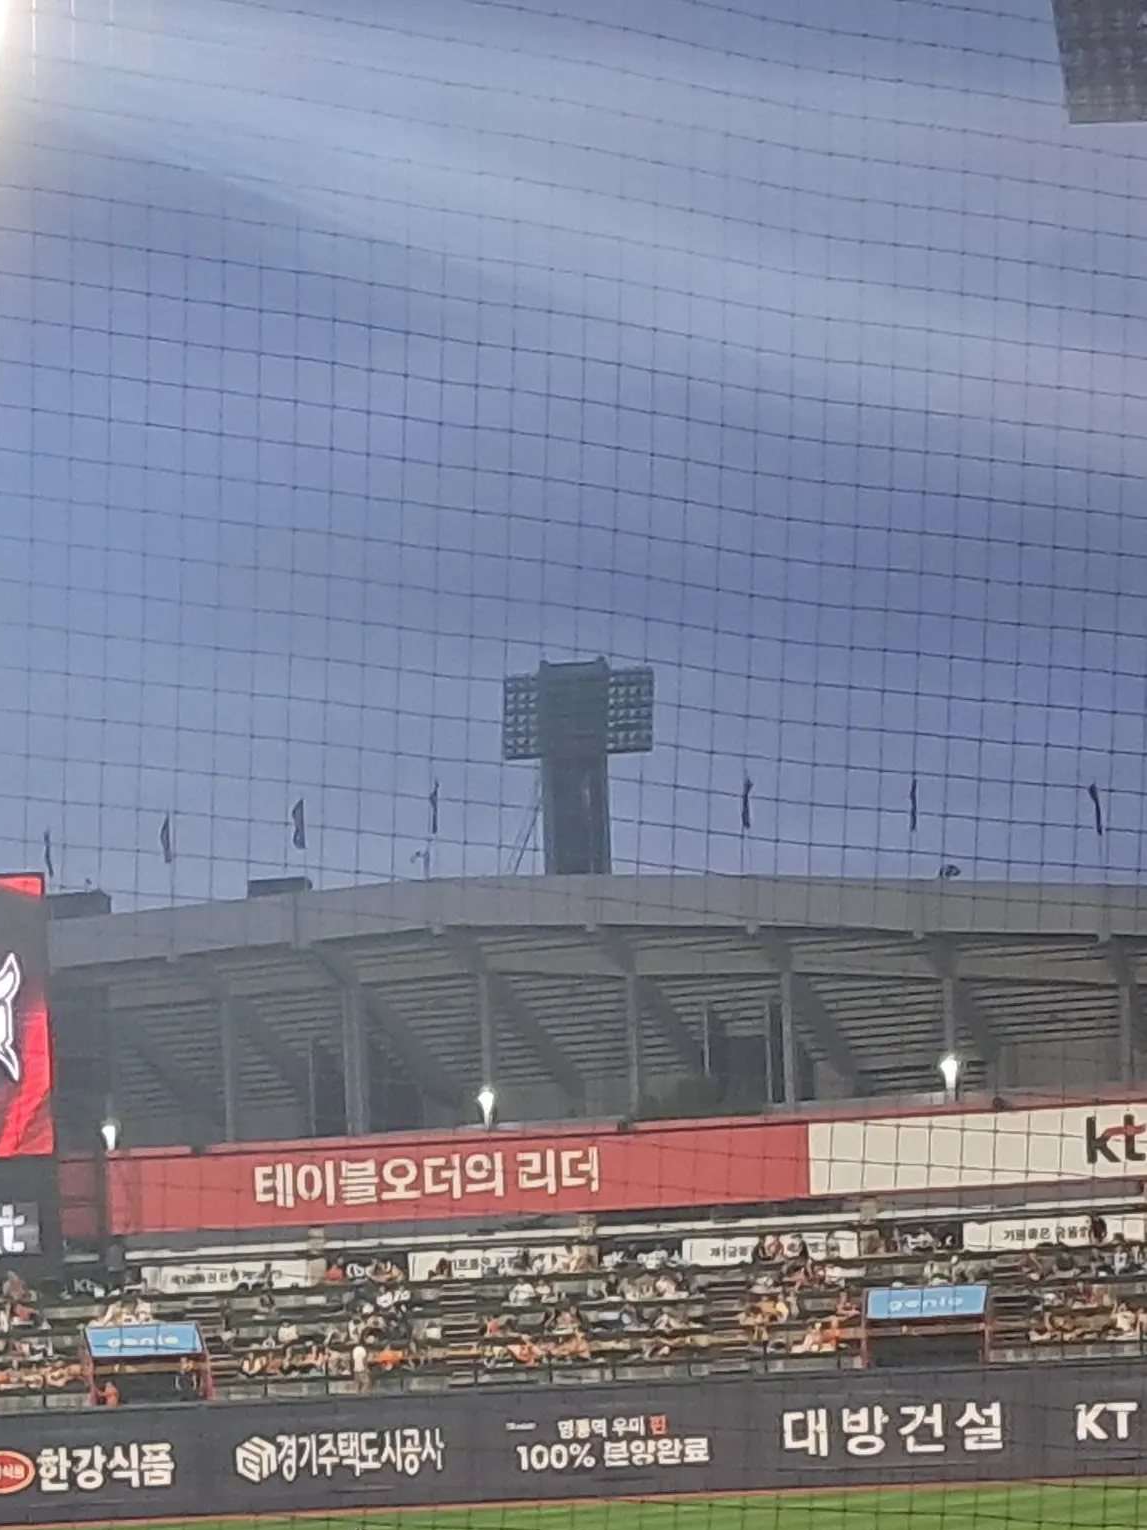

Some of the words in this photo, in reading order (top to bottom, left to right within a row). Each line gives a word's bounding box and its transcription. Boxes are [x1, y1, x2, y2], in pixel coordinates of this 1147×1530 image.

[254, 1151, 504, 1208] 테이블오더의
[517, 1147, 599, 1193] 리더
[782, 1401, 1004, 1457] 대방건설
[1075, 1402, 1138, 1441] KT
[36, 1443, 175, 1492] 한강식품
[276, 1427, 445, 1482] 경기주택도시공사
[516, 1443, 596, 1471] 100%
[604, 1437, 710, 1467] 분양완료
